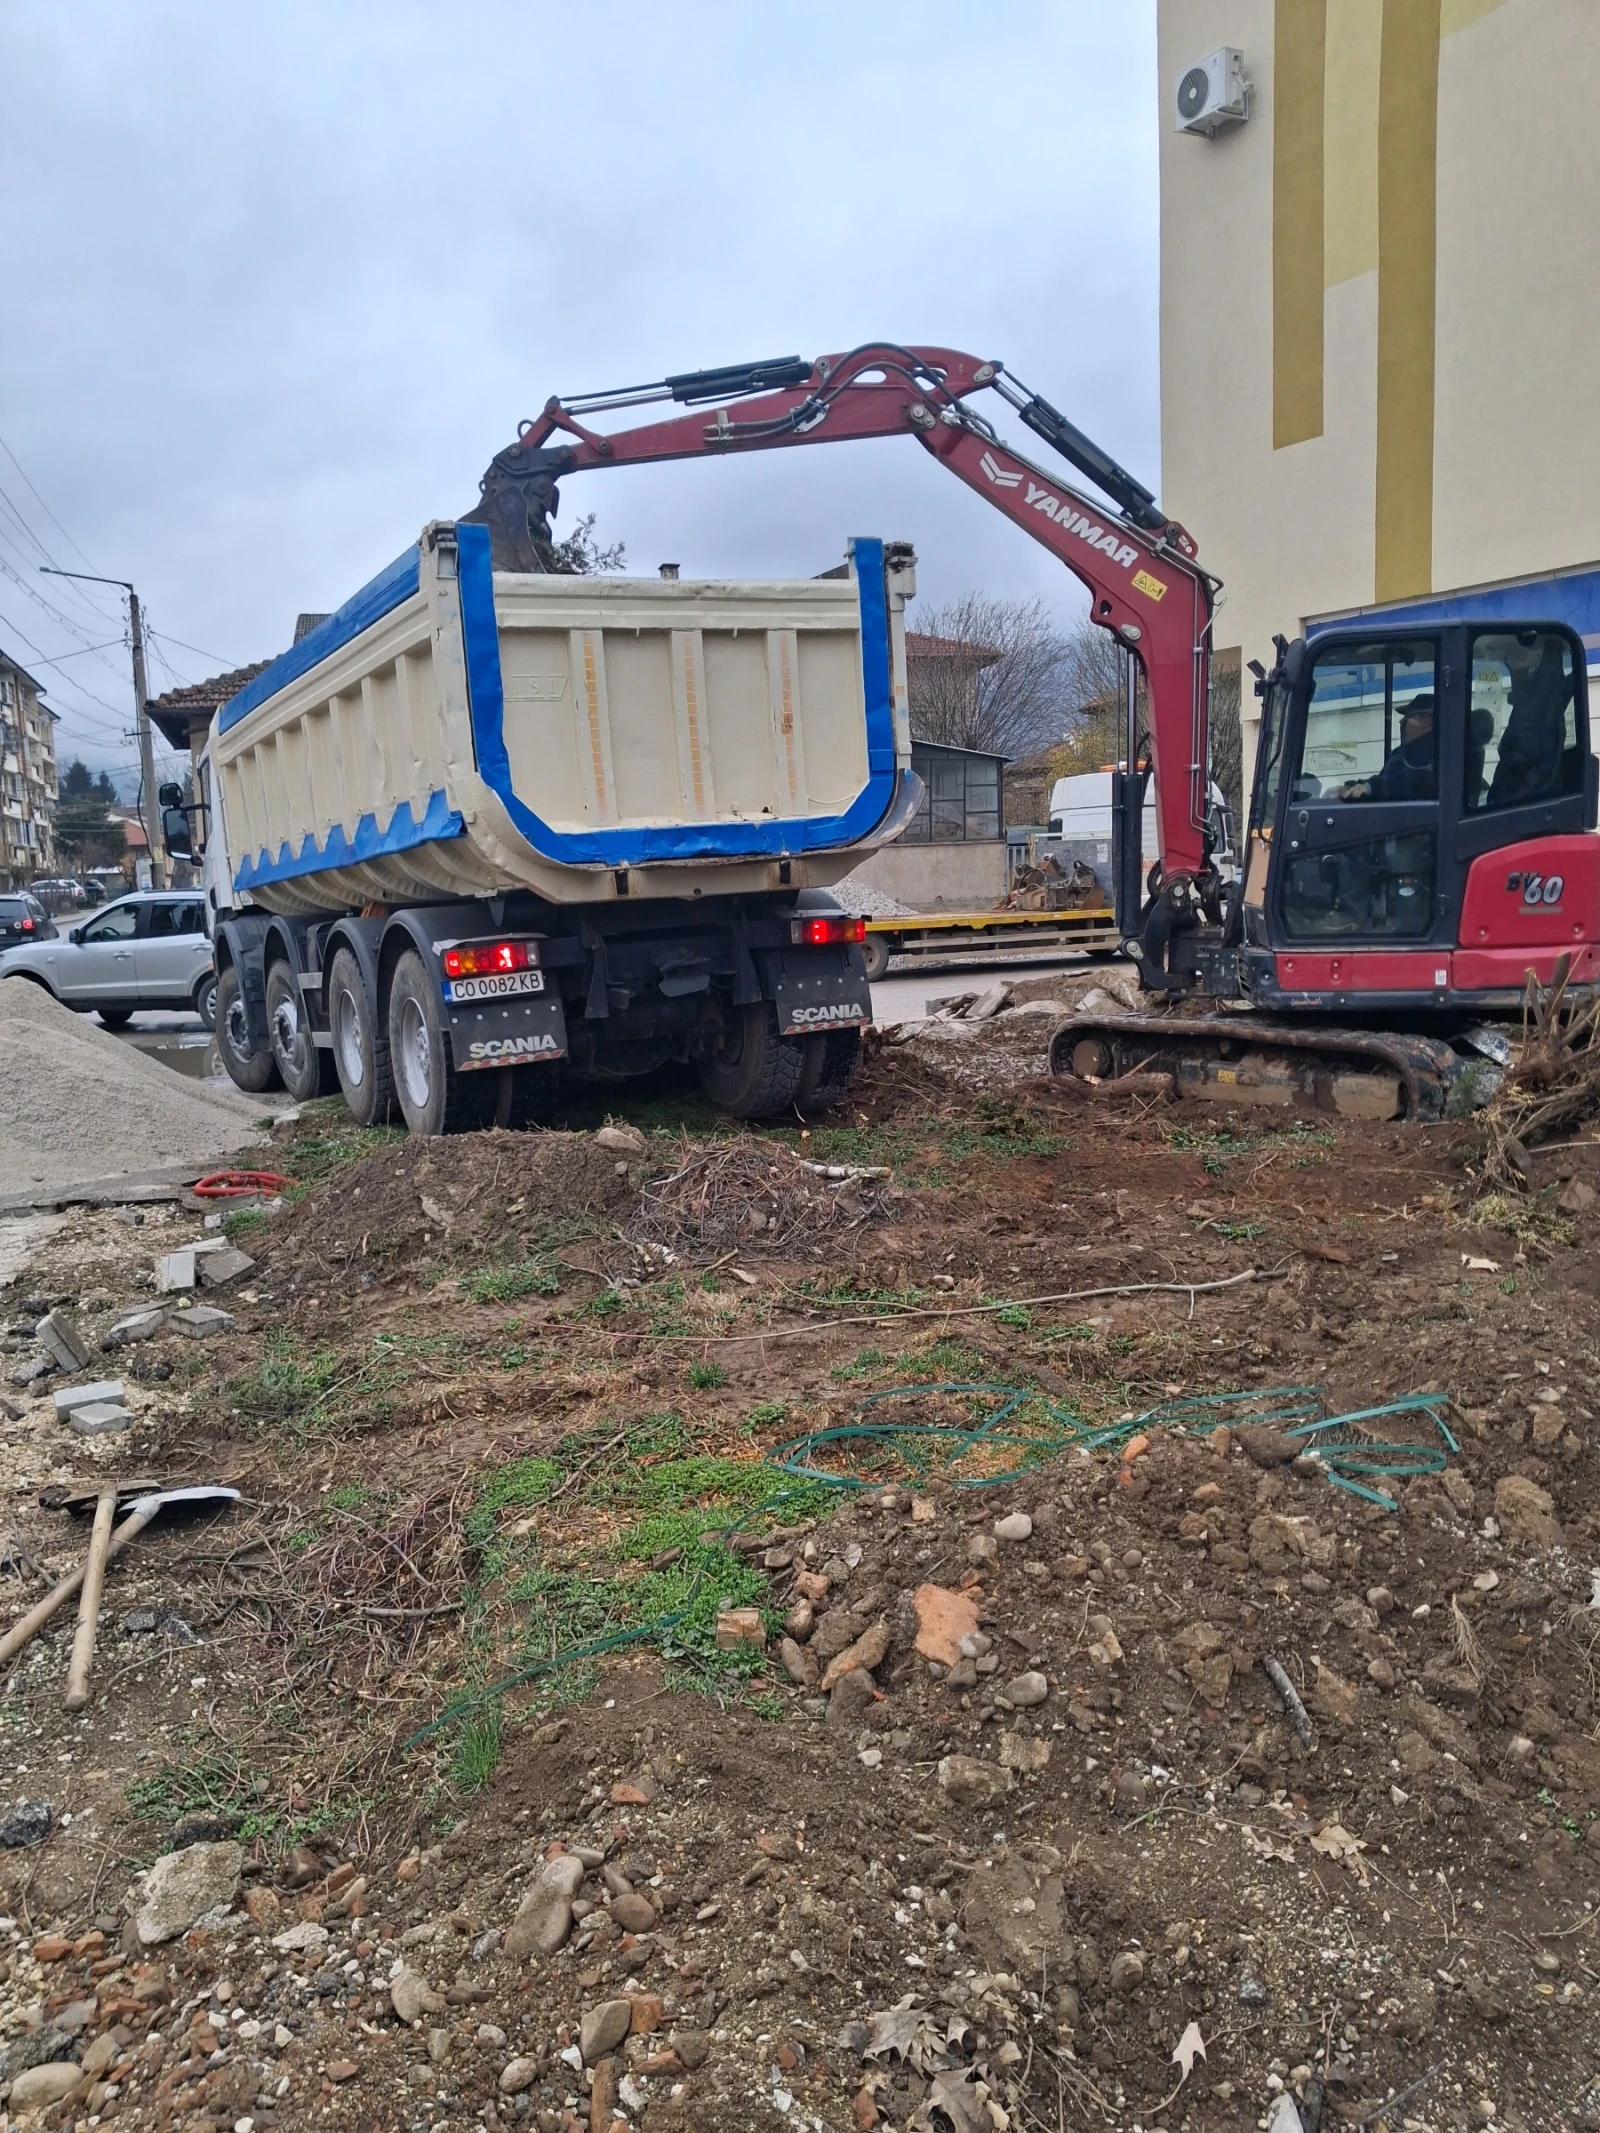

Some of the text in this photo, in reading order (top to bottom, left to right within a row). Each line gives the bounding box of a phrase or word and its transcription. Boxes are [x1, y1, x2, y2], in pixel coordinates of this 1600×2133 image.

[1023, 481, 1139, 568] YANMAR
[454, 981, 476, 998] CO
[478, 976, 517, 995] 0082
[519, 973, 540, 990] KB
[791, 1003, 864, 1023] SCANIA
[469, 1034, 557, 1058] SCANIA
